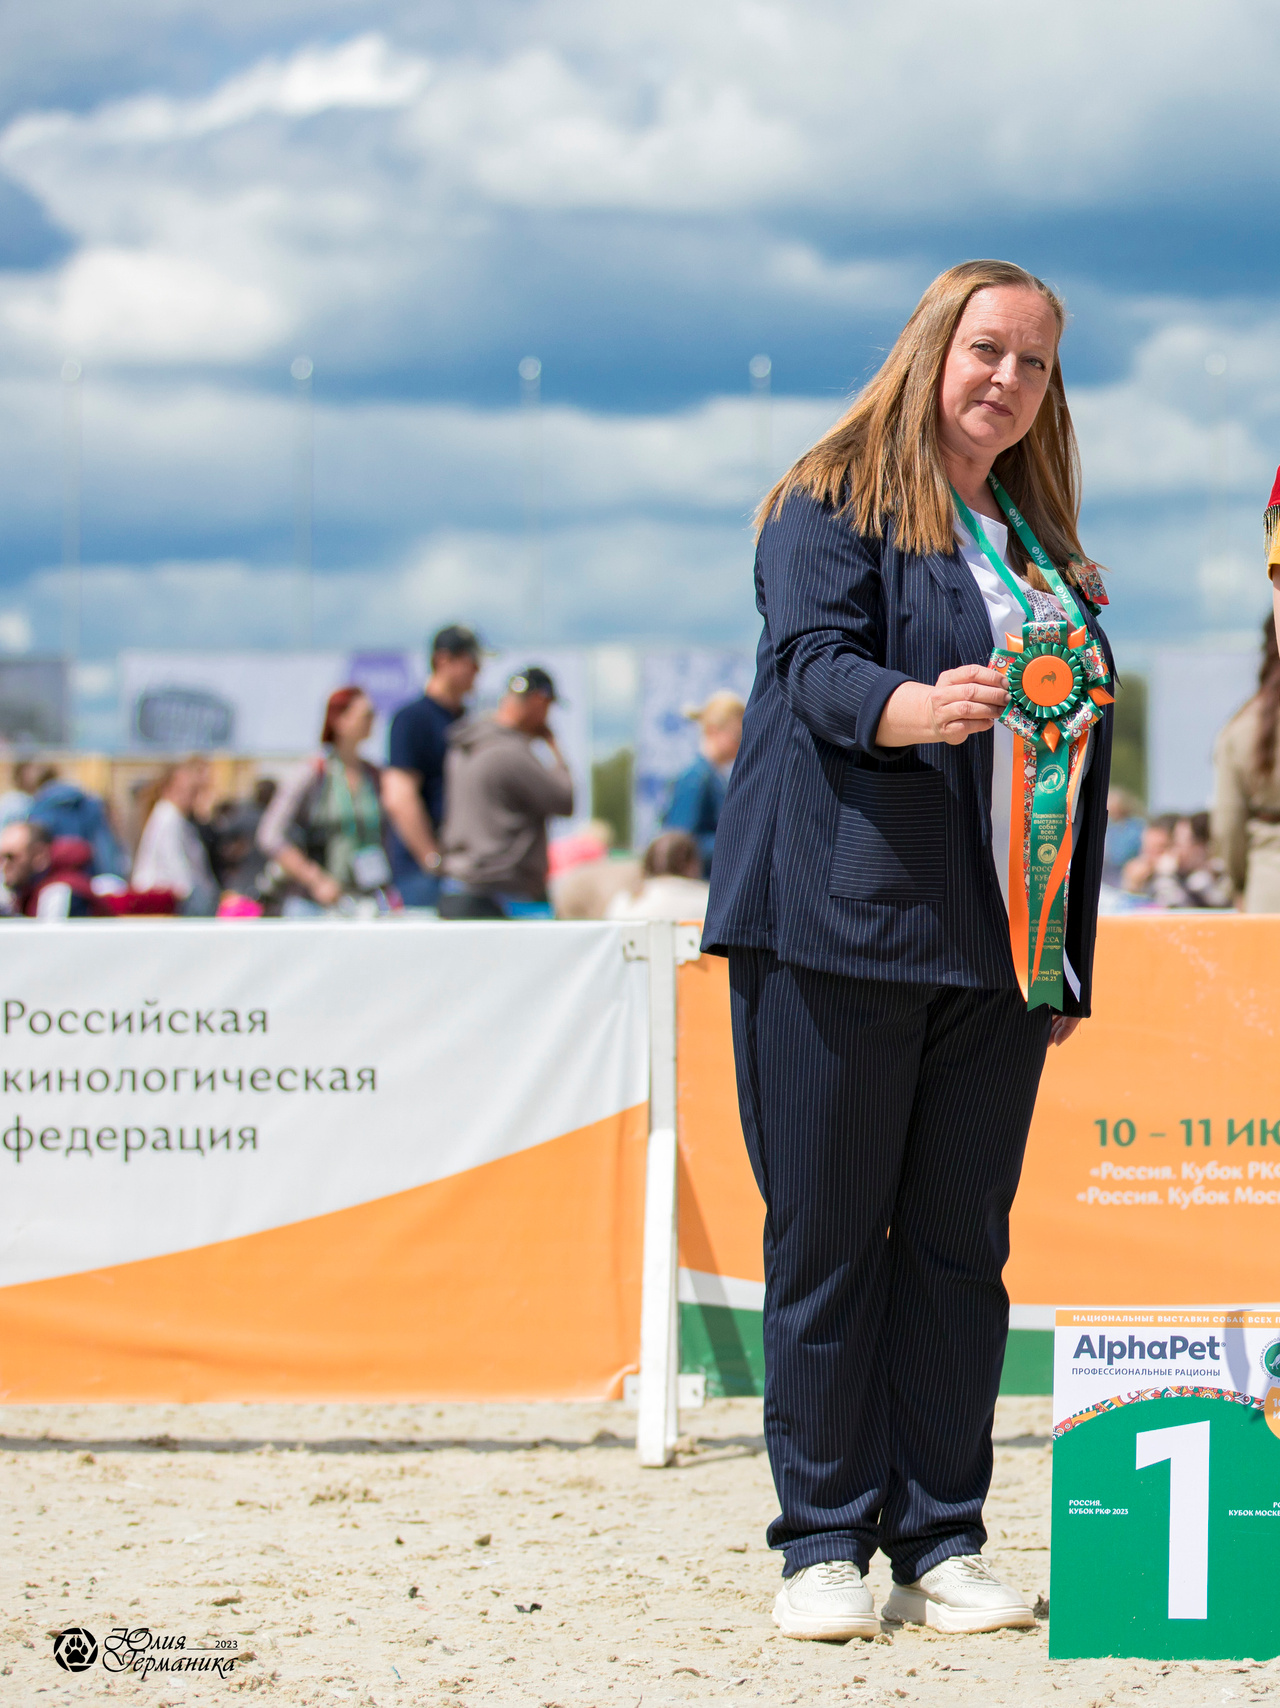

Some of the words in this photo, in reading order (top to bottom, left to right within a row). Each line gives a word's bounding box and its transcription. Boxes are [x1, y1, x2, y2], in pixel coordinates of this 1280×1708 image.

[1008, 507, 1023, 528] РКФ
[1031, 546, 1047, 566] РКФ
[1055, 585, 1071, 605] РКФ
[1031, 865, 1053, 873] РОСС
[3, 1000, 269, 1034] Российская
[3, 1066, 378, 1094] кинологическая
[3, 1116, 258, 1162] федерация
[1094, 1118, 1136, 1147] 10
[1180, 1118, 1211, 1147] 11
[1181, 1160, 1243, 1184] Кубок
[1168, 1185, 1230, 1210] Кубок
[1072, 1314, 1155, 1324] НАЦИОНАЛЬНЫЕ
[1157, 1315, 1209, 1324] ВЫСТАВКИ
[1212, 1316, 1245, 1324] СОБАК
[1248, 1316, 1272, 1324] ВСЕХ
[1072, 1334, 1221, 1365] AlphaPet
[1071, 1367, 1173, 1377] ПРОФЕССИОНАЛЬНЫЕ
[1175, 1368, 1221, 1377] РАЦИОНЫ
[1068, 1499, 1102, 1507] РОССИЯ.
[1228, 1509, 1254, 1517] КУБОК
[1136, 1420, 1210, 1620] 1
